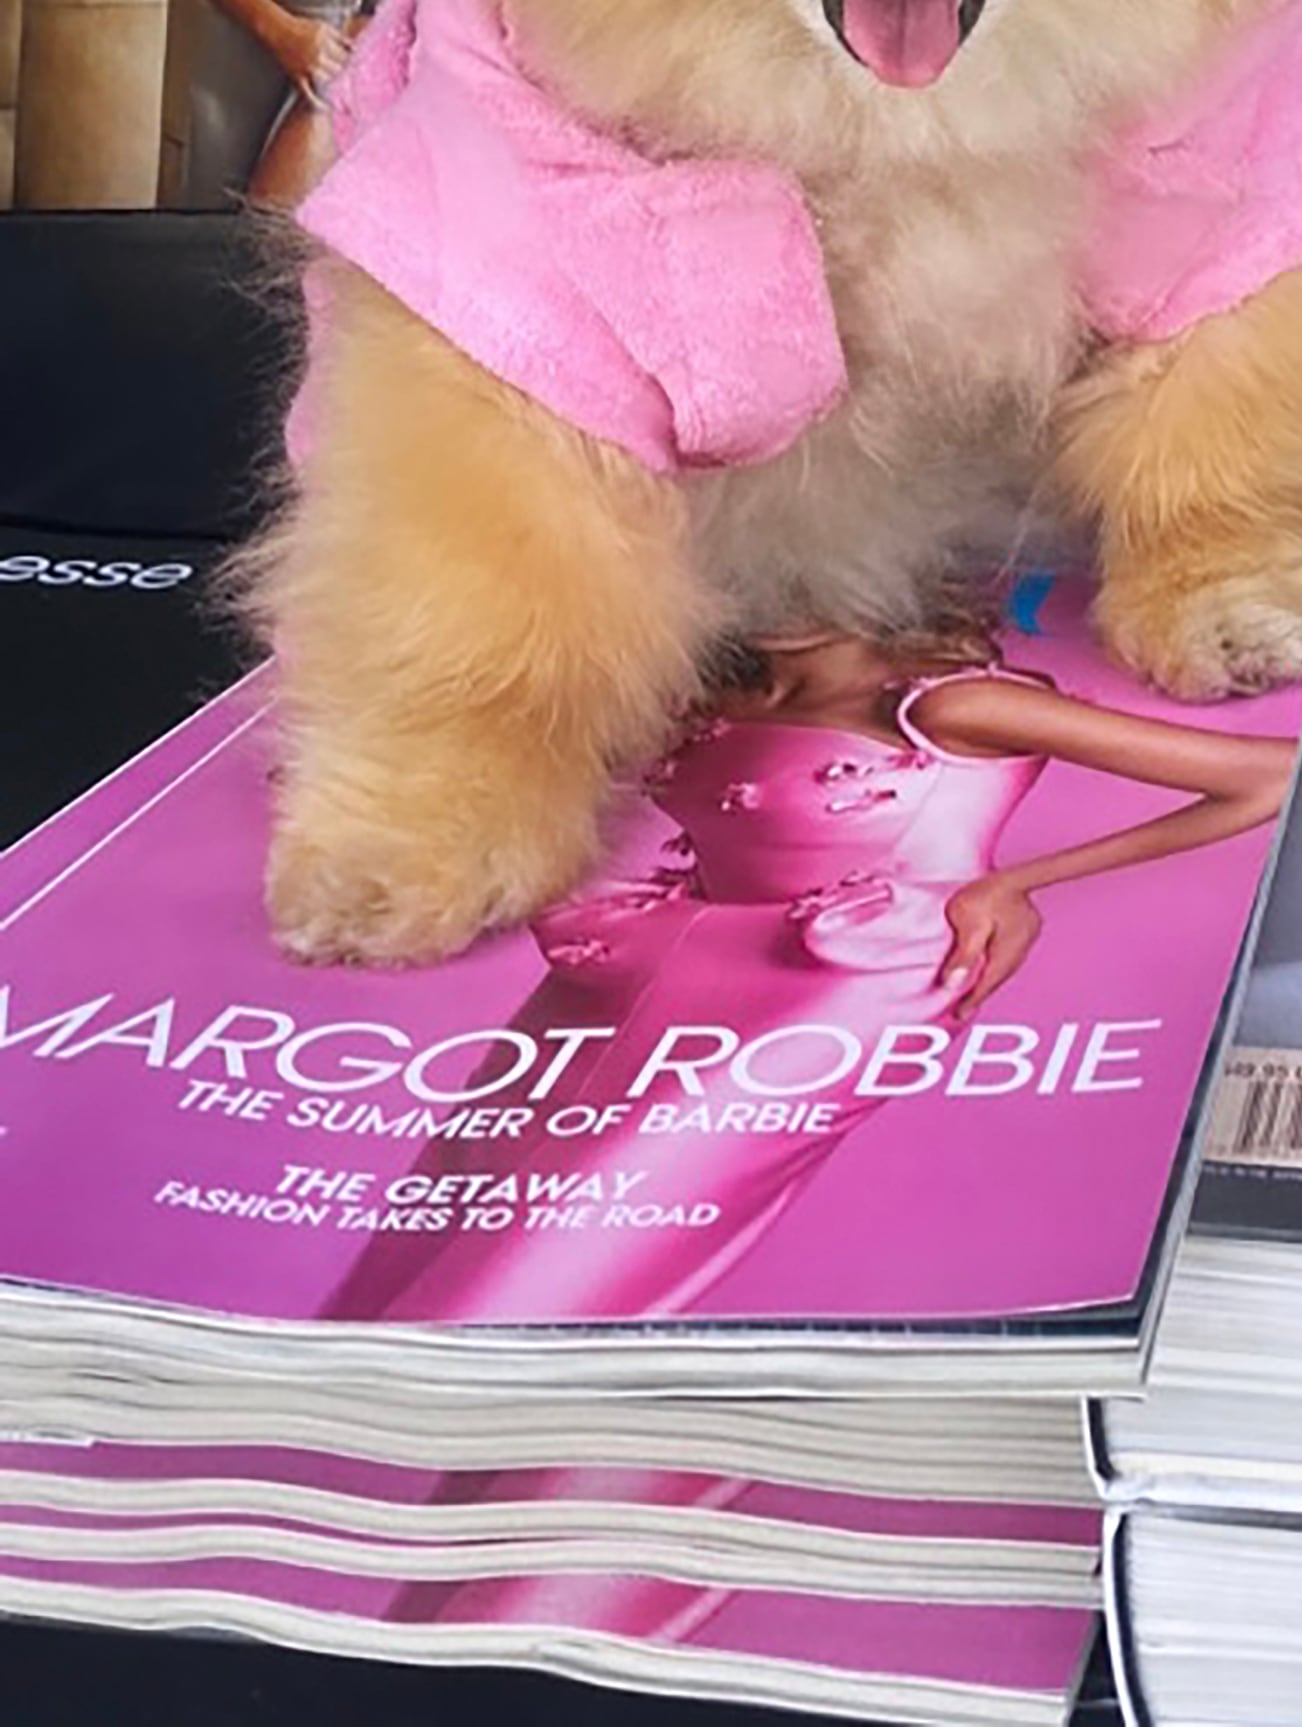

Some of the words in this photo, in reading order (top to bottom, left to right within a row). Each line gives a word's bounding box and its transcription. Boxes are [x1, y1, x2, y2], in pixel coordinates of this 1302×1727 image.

[0, 556, 193, 589] esse
[0, 984, 613, 1103] MARGOT
[626, 1018, 1162, 1100] ROBBIE
[178, 1079, 285, 1121] THE
[287, 1097, 530, 1139] SUMMER
[545, 1104, 633, 1137] OF
[637, 1103, 841, 1135] BARBIE
[153, 1180, 332, 1229] FASHION
[335, 1203, 451, 1233] TAKES
[459, 1205, 515, 1233] TO
[522, 1203, 598, 1230] THE
[602, 1203, 722, 1229] ROAD
[273, 1165, 377, 1204] THE
[384, 1172, 648, 1206] GETAWAY
